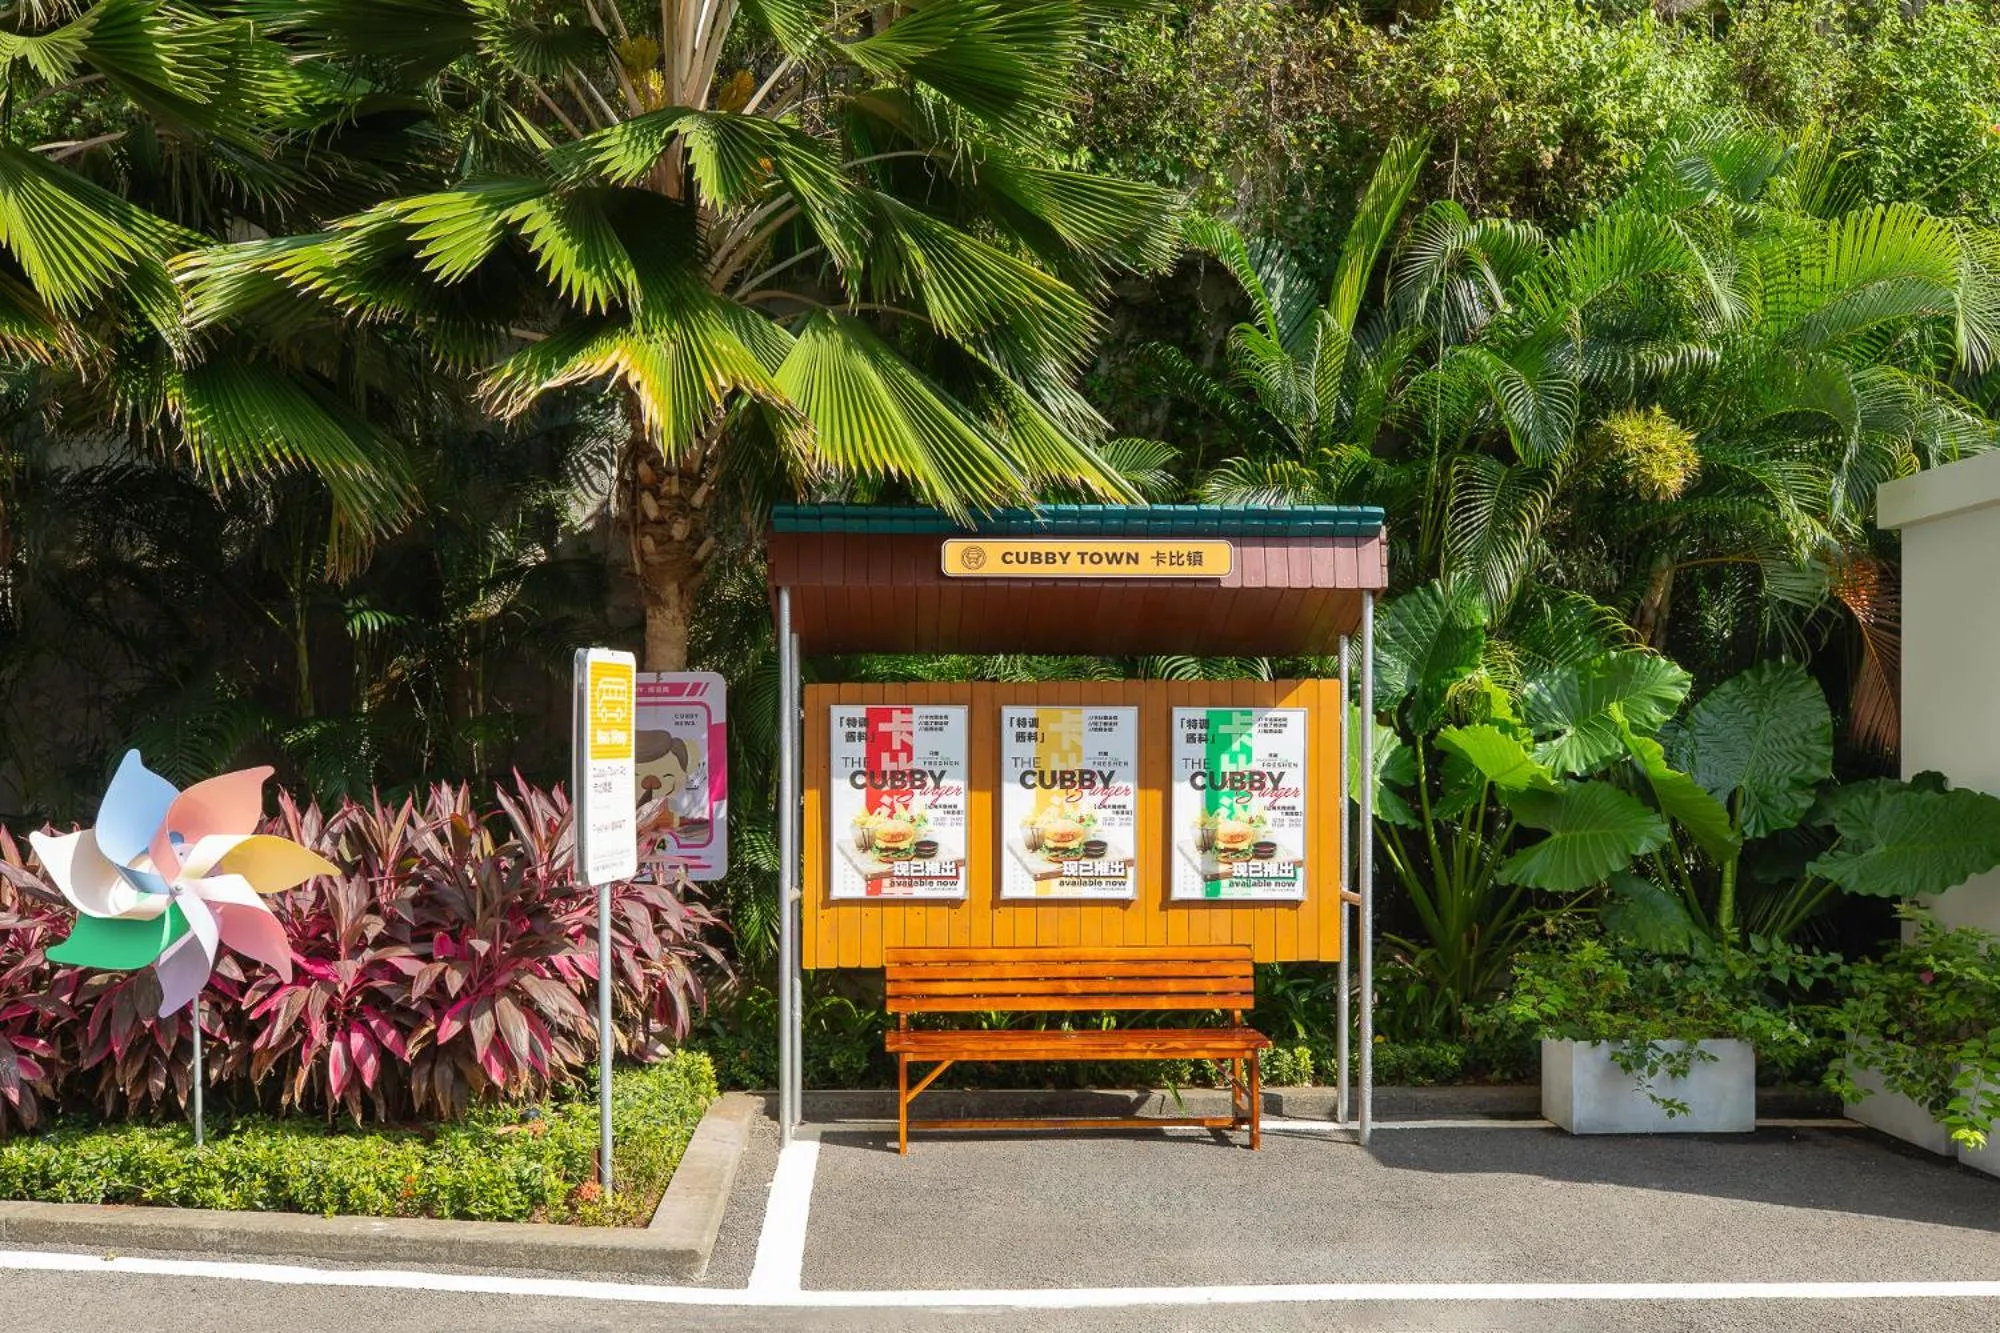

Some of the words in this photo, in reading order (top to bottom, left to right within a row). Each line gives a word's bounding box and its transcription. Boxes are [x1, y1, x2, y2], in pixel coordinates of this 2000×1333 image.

[1001, 551, 1069, 565] CUBBY
[1077, 551, 1139, 565] TOWN
[1150, 551, 1203, 566] 卡比镇
[841, 757, 871, 768] THE
[1011, 757, 1041, 768] THE
[1182, 758, 1211, 769] THE
[849, 770, 947, 790] CUBBY
[1019, 770, 1116, 790] CUBBY
[1190, 771, 1286, 791] CUBBY
[890, 879, 934, 887] available
[1059, 879, 1103, 887] available
[1229, 880, 1272, 888] available
